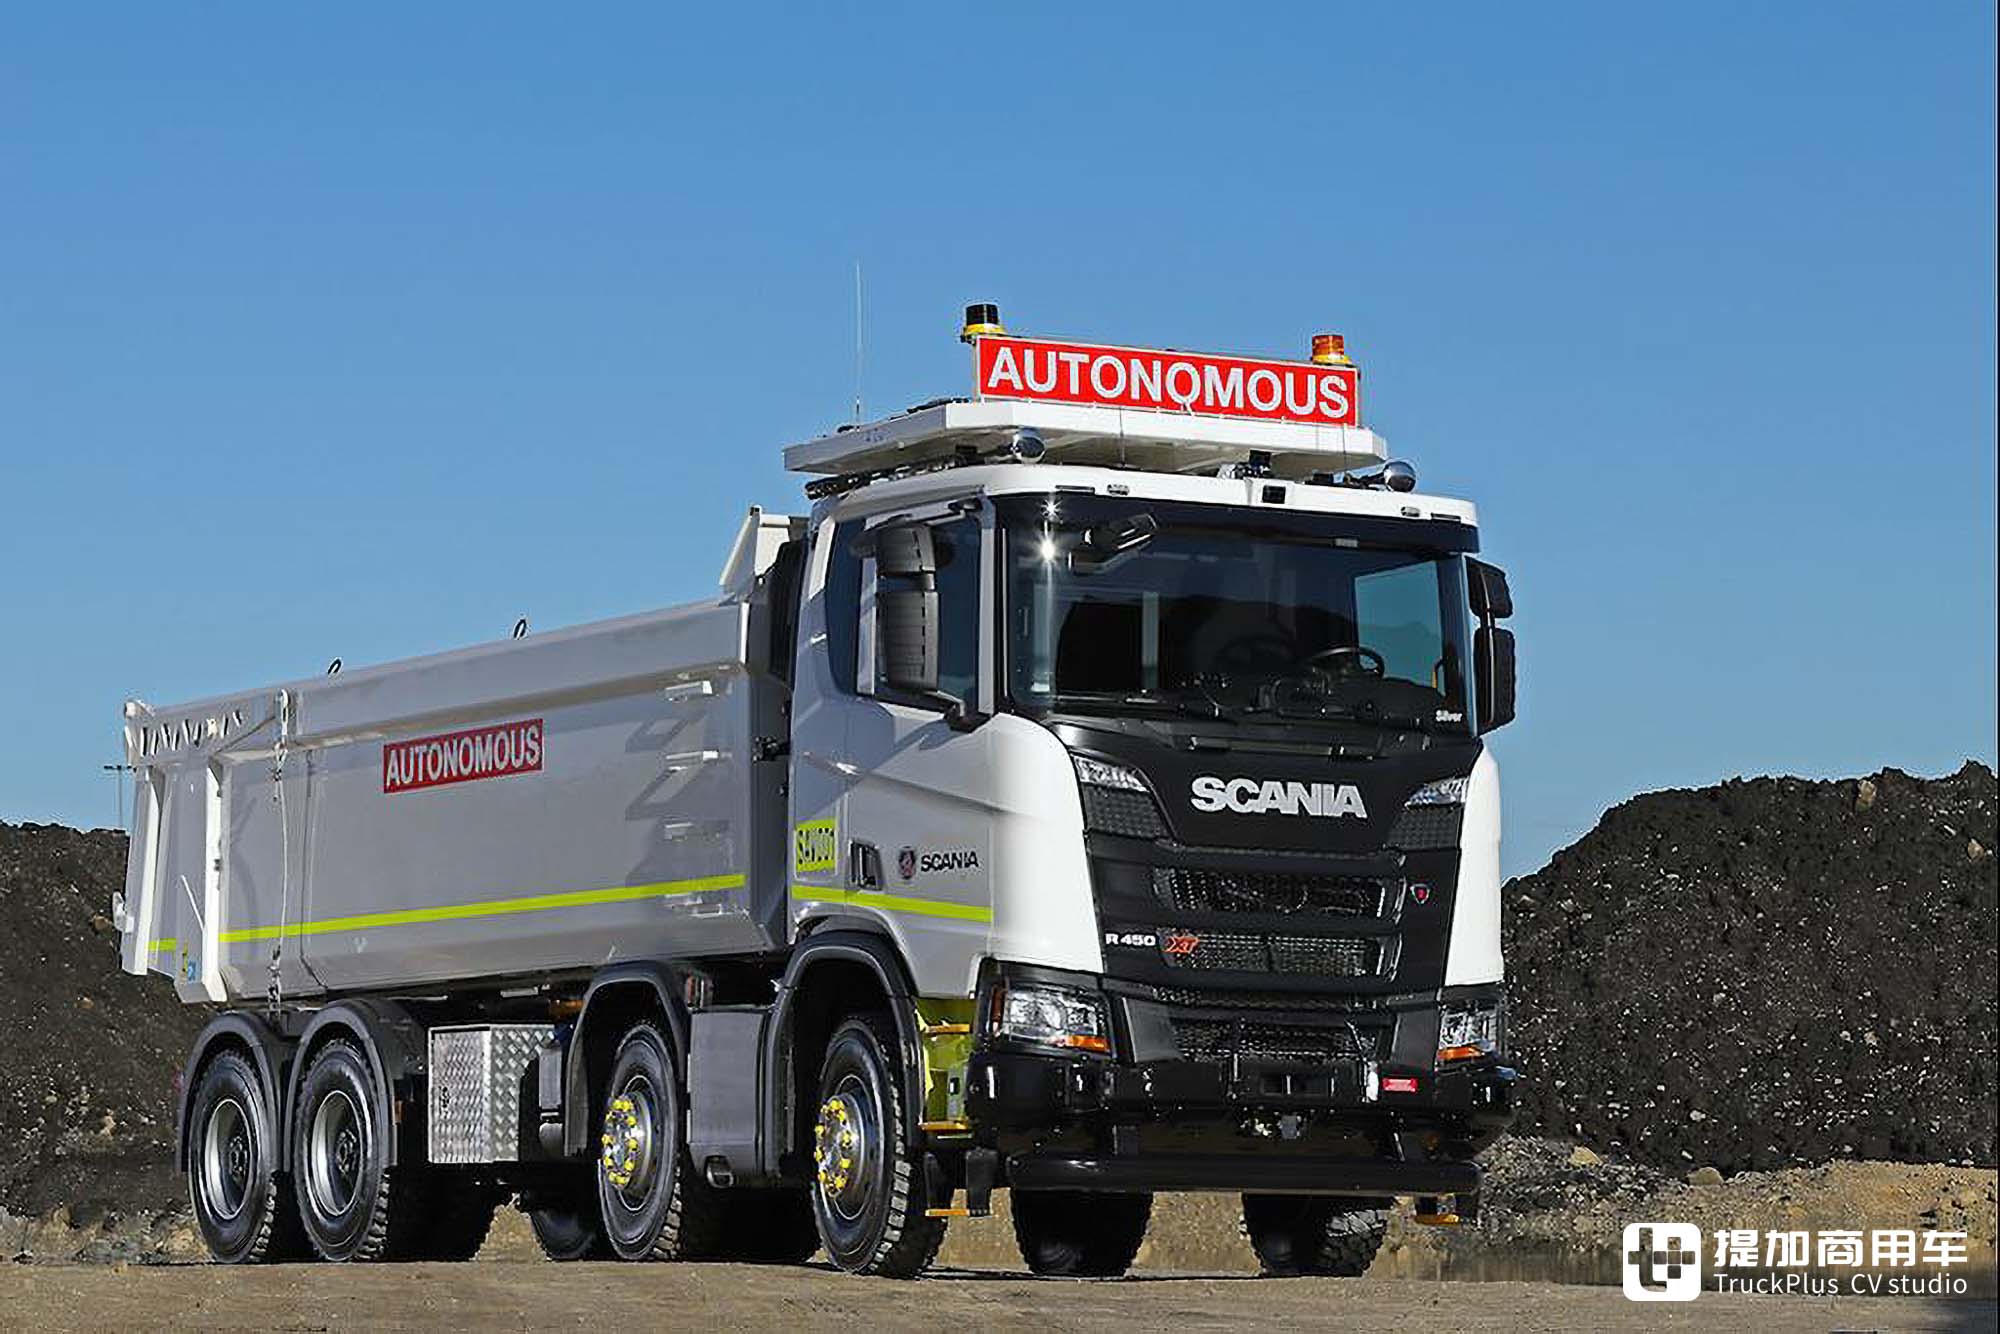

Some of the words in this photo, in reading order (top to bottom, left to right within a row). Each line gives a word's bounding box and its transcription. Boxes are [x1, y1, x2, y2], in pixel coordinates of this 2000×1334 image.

[987, 346, 1349, 418] AUTONOMOUS
[385, 724, 540, 788] AUTONOMOUS
[1190, 776, 1368, 819] SCANIA
[920, 850, 979, 873] SCANIA
[1104, 932, 1119, 945] R
[1120, 933, 1157, 947] 450
